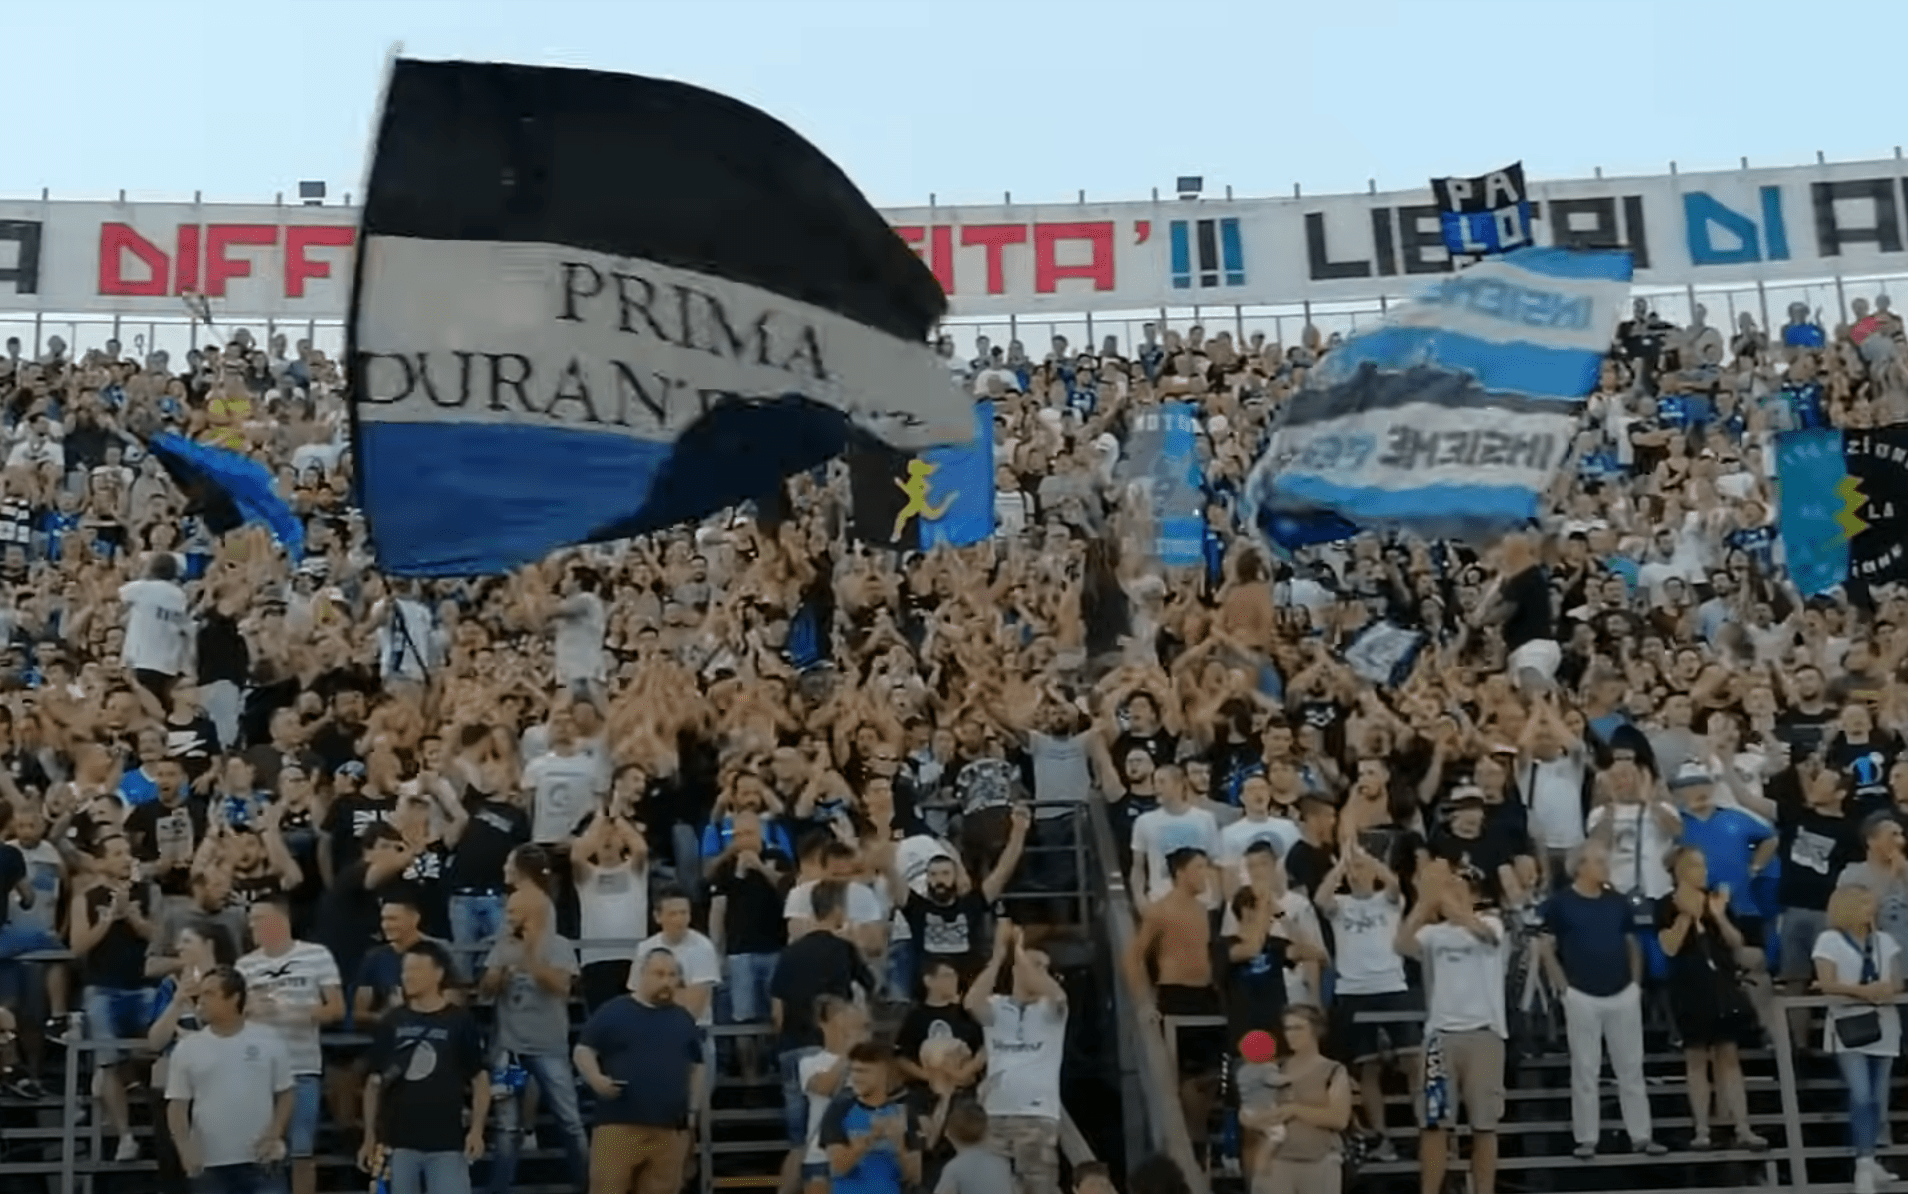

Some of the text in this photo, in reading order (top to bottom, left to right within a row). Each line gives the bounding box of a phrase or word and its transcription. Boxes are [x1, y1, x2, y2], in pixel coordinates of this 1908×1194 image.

[1446, 171, 1519, 212] PA
[1459, 204, 1526, 252] LO
[1683, 184, 1791, 267] DI
[556, 261, 829, 381] PRIMA
[357, 350, 738, 430] DURAN
